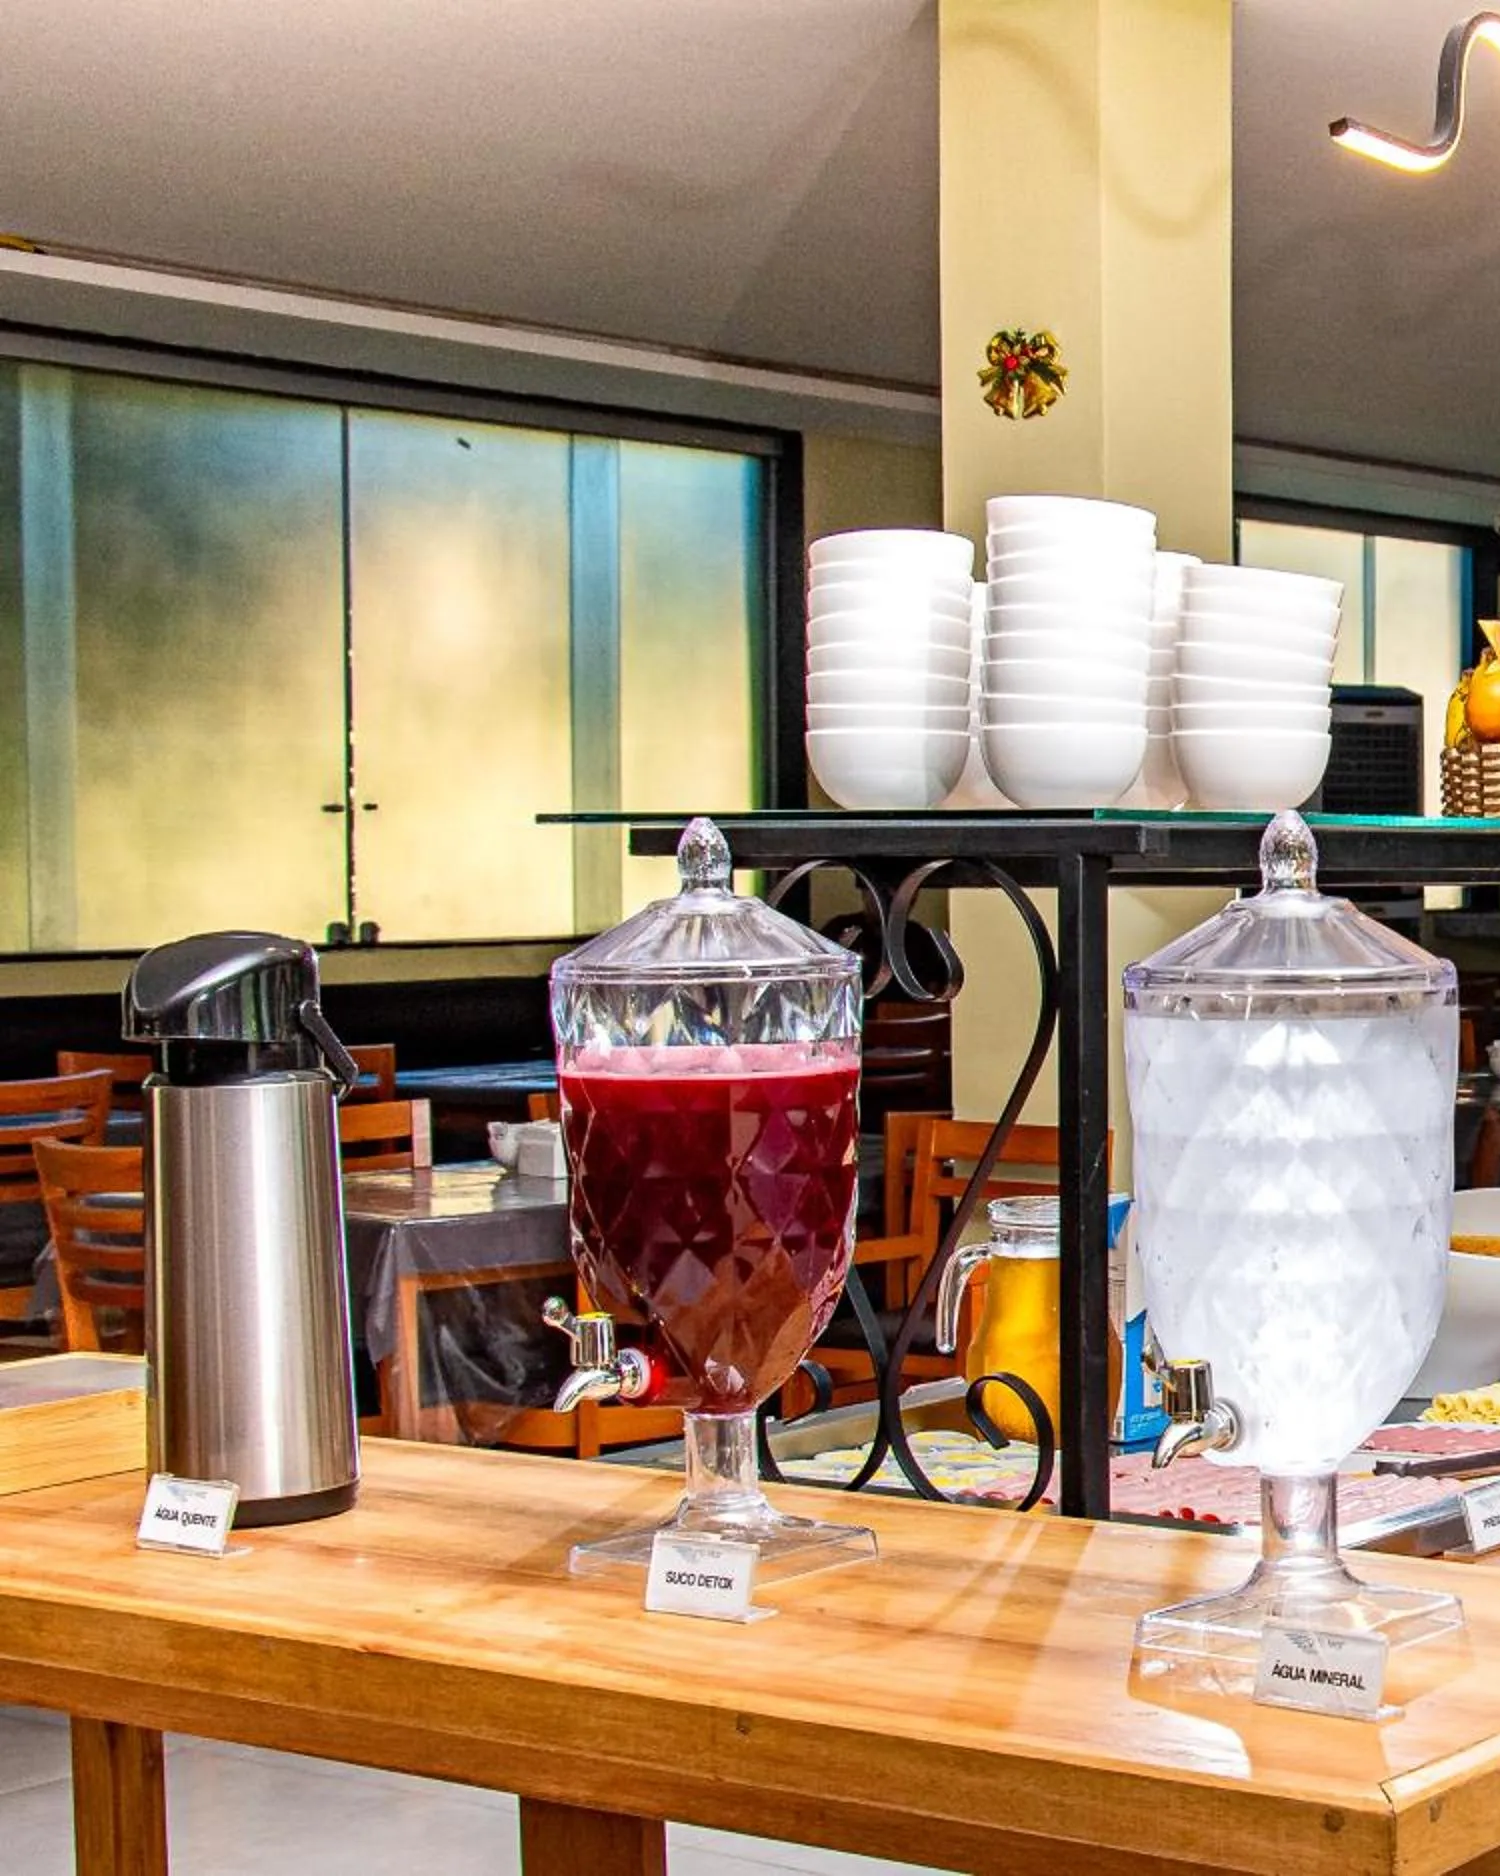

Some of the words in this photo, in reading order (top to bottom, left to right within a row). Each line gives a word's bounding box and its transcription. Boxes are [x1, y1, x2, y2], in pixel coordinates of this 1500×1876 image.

[154, 1504, 179, 1521] ÁGUA
[181, 1511, 218, 1528] QUENTE
[665, 1571, 696, 1586] SUCO
[697, 1573, 734, 1590] DETOX
[1271, 1659, 1306, 1681] ÁGUA
[1309, 1669, 1366, 1690] MINERAL
